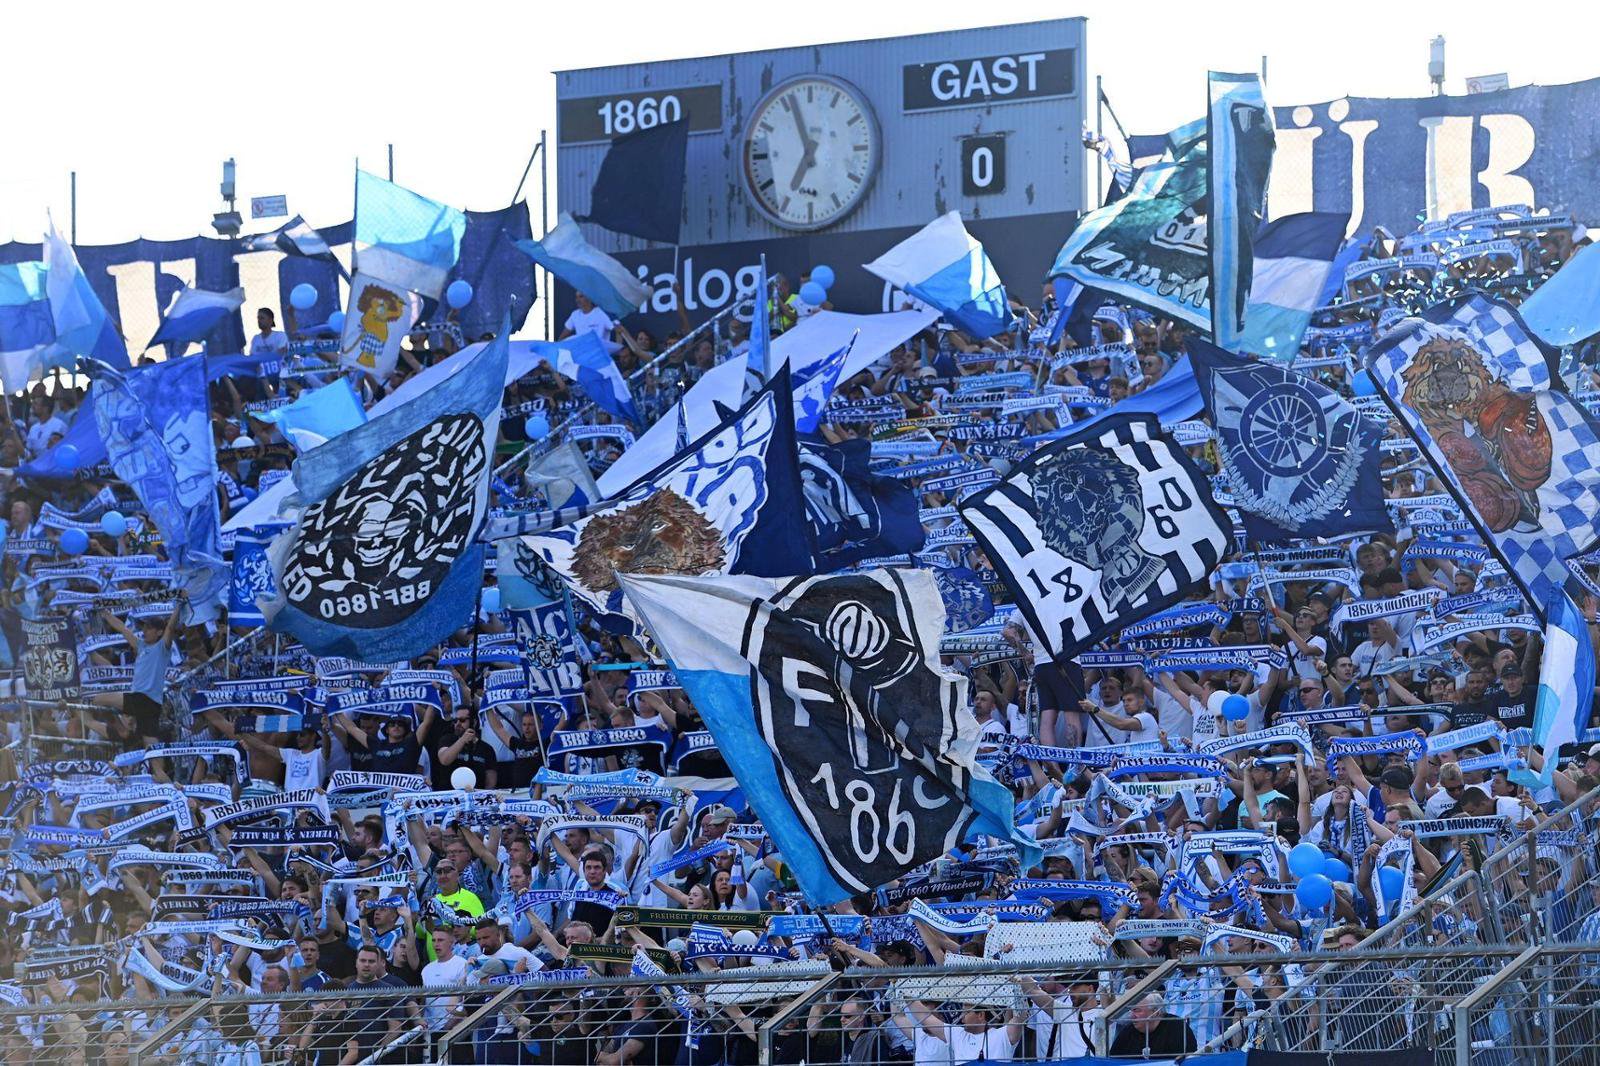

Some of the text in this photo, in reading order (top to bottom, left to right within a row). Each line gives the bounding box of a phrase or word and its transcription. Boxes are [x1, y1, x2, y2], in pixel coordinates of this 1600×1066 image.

[931, 52, 1046, 101] GAST
[598, 95, 681, 136] 1860
[971, 147, 992, 187] 0
[637, 256, 762, 323] ialog
[950, 427, 983, 440] CHEN
[1348, 602, 1374, 618] 1860
[1121, 618, 1159, 637] reiheit
[636, 673, 664, 687] BBF
[338, 686, 427, 707] BBF 1860
[560, 728, 647, 748] BBF 1860
[1201, 732, 1246, 754] UTSCHER
[334, 773, 359, 787] 1860
[211, 803, 242, 819] 1860
[544, 816, 559, 830] TSV
[1419, 820, 1444, 834] 1860
[930, 879, 982, 894] München
[650, 912, 689, 921] FREIHEIT
[712, 913, 747, 922] SECHZIG
[795, 917, 811, 929] DIE
[1161, 921, 1189, 930] IMMER
